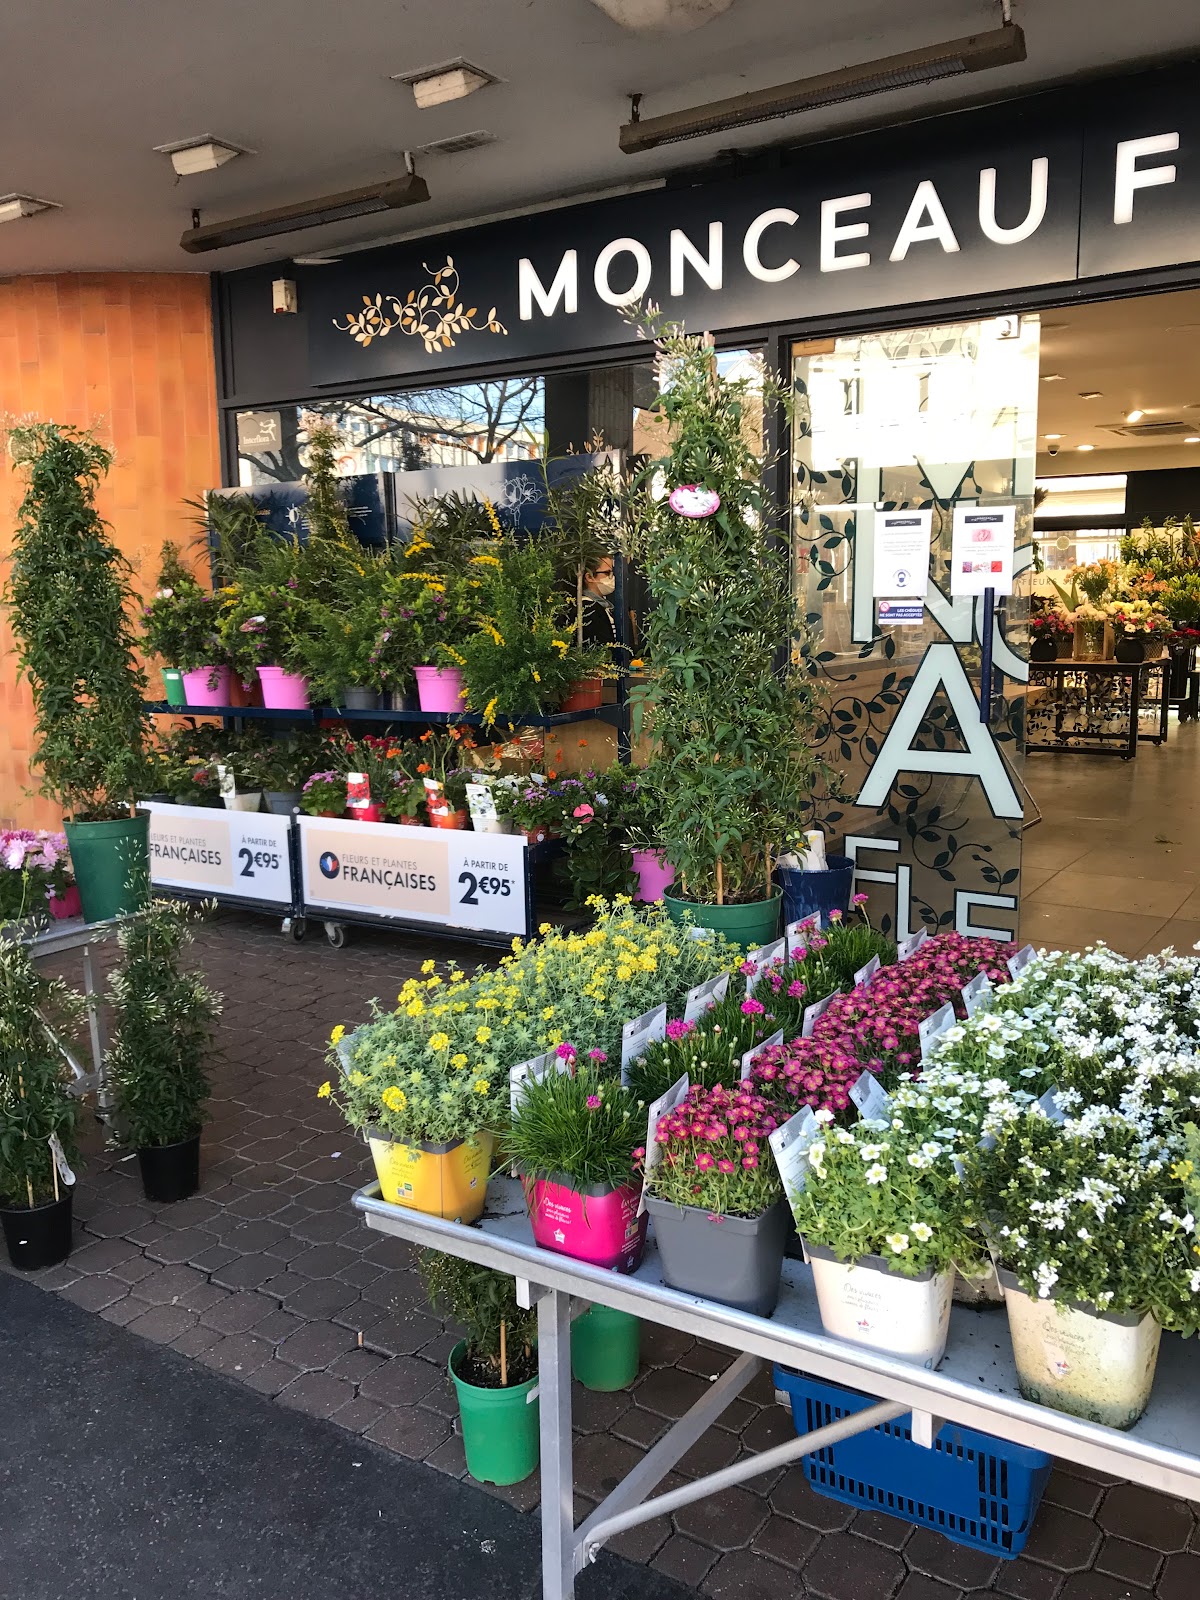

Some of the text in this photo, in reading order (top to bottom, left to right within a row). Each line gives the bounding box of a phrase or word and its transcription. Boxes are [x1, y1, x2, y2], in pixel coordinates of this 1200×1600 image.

[518, 131, 1180, 321] MONCEAU F
[242, 434, 270, 445] Interflora
[150, 833, 207, 847] LEURS ET PLANTES
[241, 834, 277, 848] À PARTIR DE
[342, 853, 418, 871] FLEURS ET PLANTES
[463, 857, 509, 872] À PARTIR DE
[343, 866, 437, 892] FRANÇAISES
